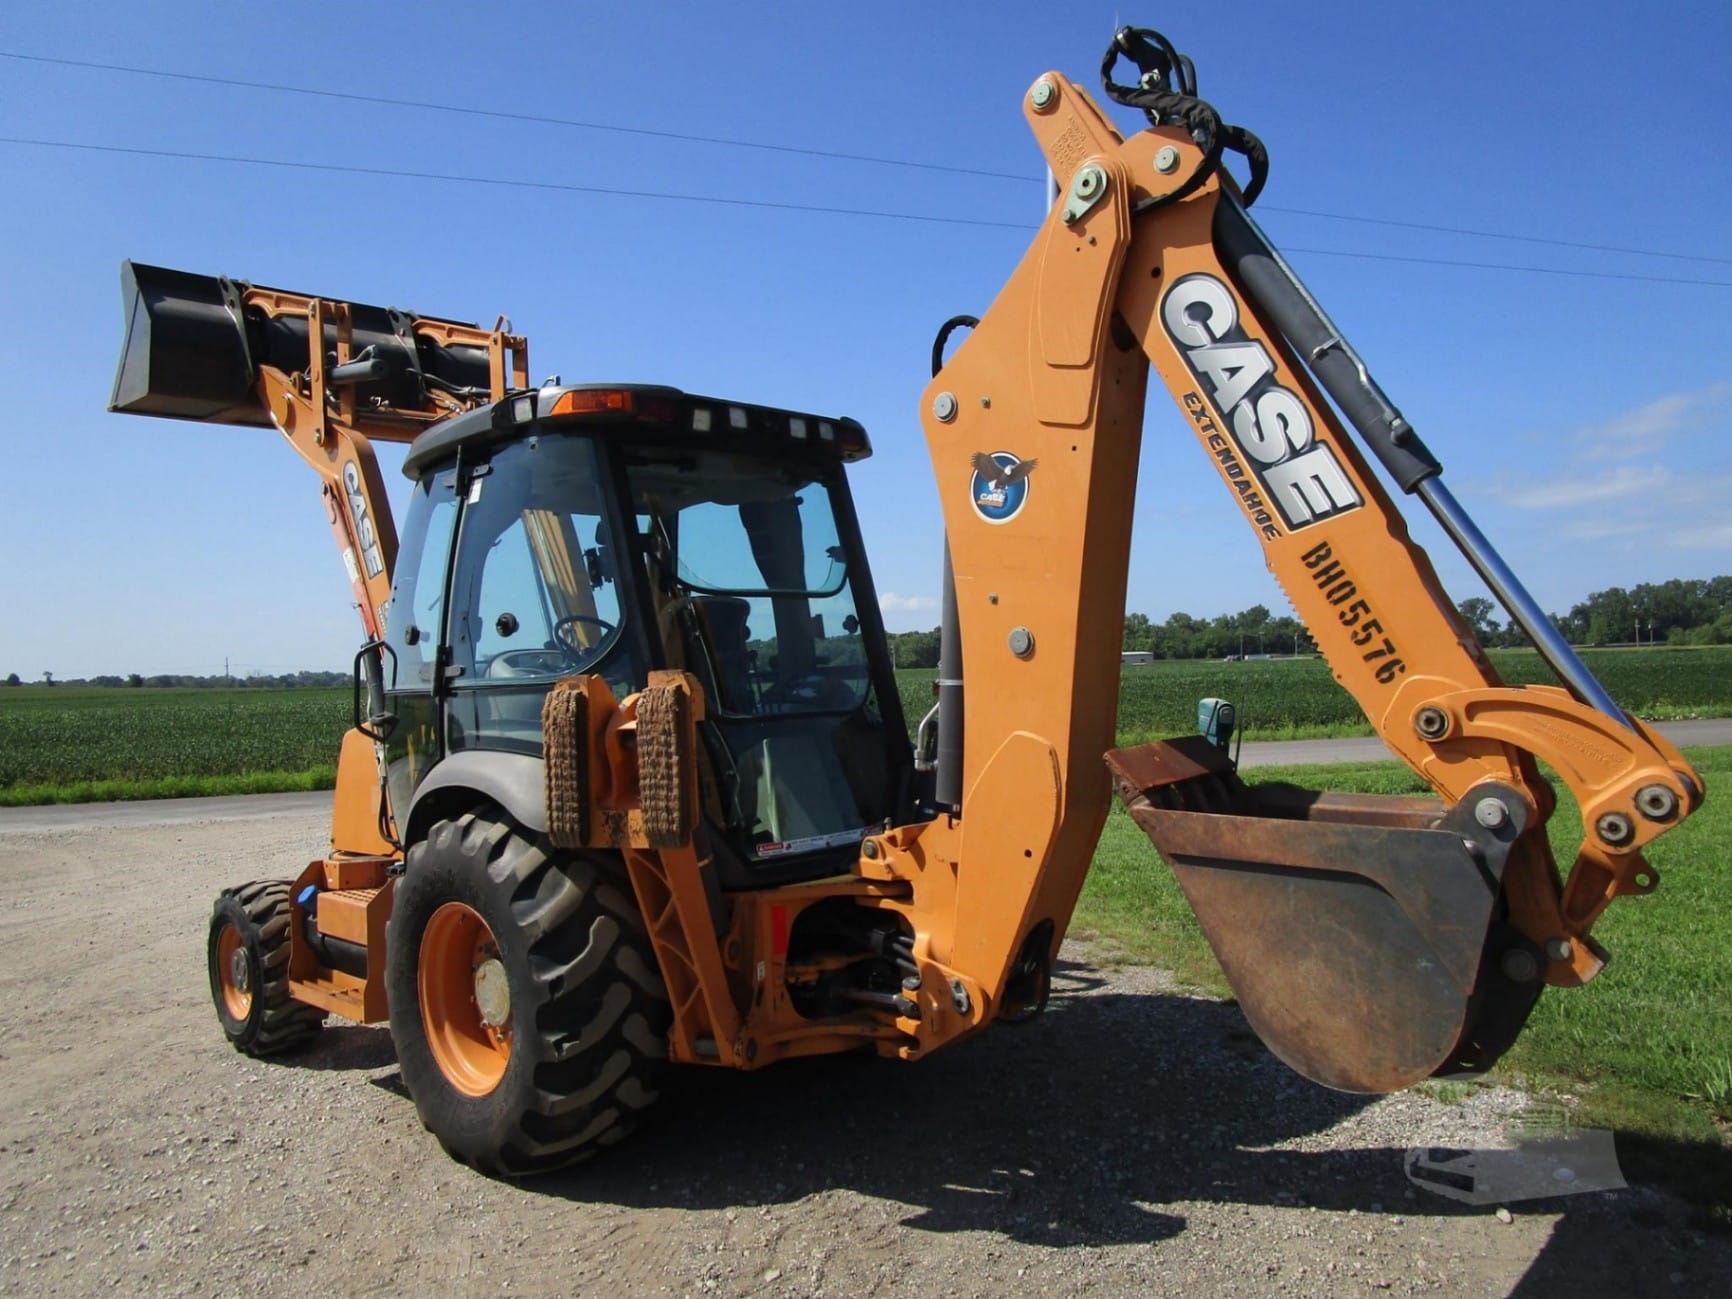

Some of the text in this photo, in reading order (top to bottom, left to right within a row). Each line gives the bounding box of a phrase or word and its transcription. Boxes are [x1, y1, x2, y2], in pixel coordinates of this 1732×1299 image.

[1162, 275, 1363, 527] CASE
[1183, 391, 1282, 541] EXTENDAHOE
[343, 461, 384, 579] CASE
